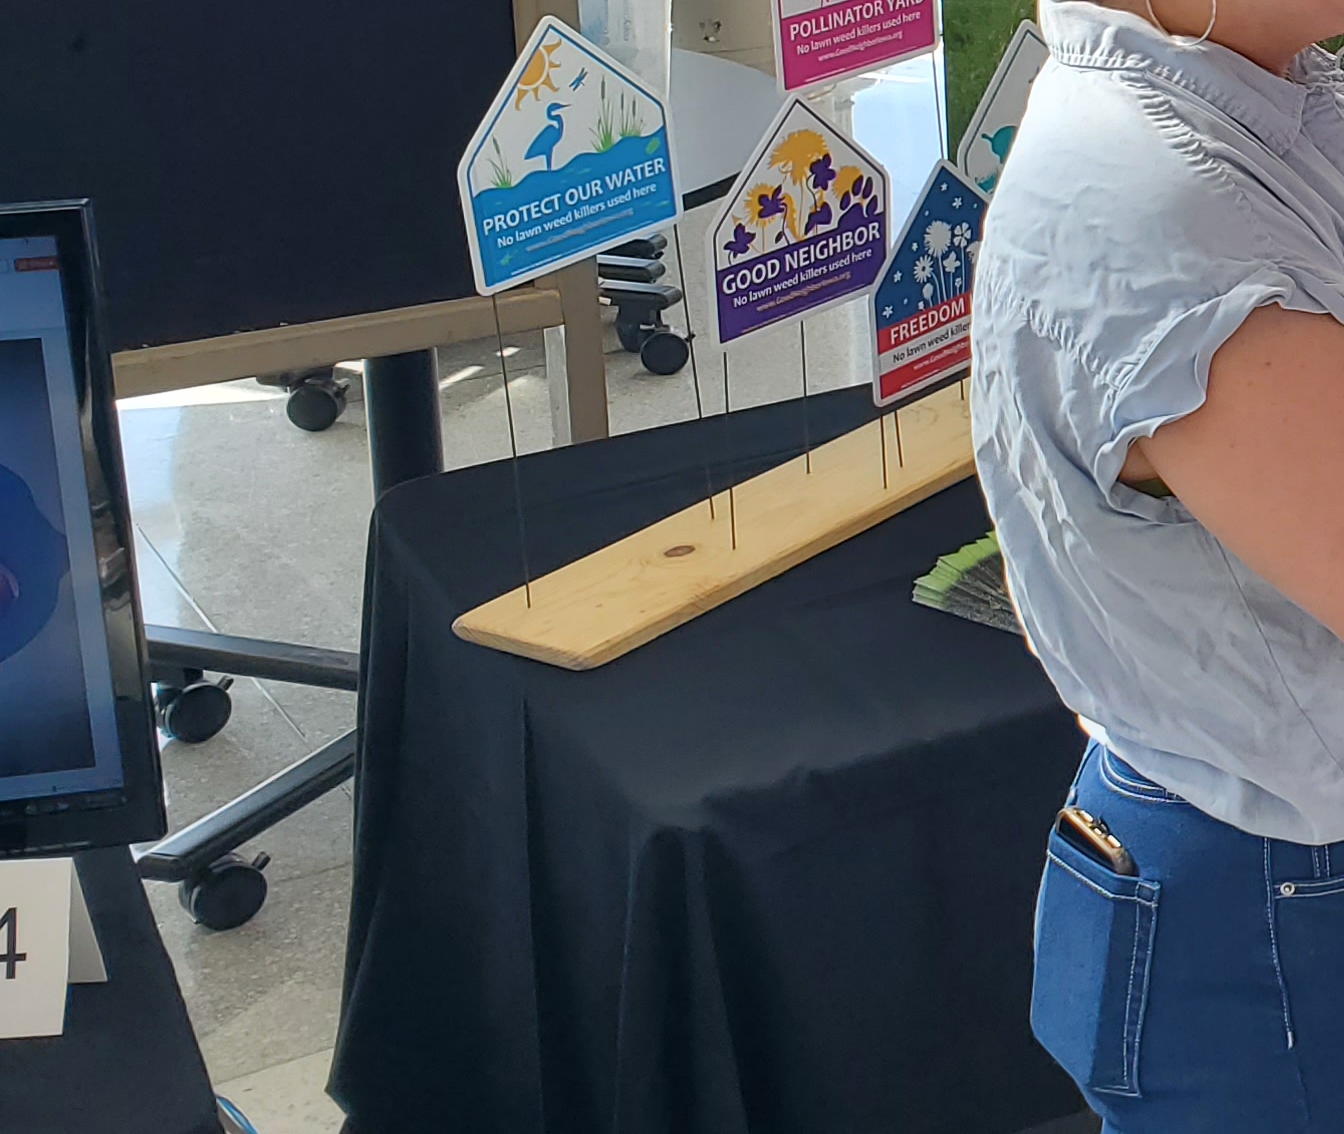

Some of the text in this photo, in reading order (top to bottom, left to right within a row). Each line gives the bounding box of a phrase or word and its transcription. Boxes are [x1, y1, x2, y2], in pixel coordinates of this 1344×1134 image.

[789, 0, 884, 42] POLLINATOR
[796, 10, 921, 56] No lawn weed killers used here
[482, 193, 562, 237] PROTECT
[564, 179, 604, 206] OUR
[604, 157, 667, 192] WATER
[497, 236, 514, 249] No
[515, 224, 542, 242] lawn
[543, 211, 573, 231] weed
[574, 202, 606, 221] killers
[607, 189, 632, 209] used
[632, 183, 657, 199] here
[722, 222, 881, 295] GOOD NEIGHBOR
[733, 248, 873, 308] No lawn weed killers used here
[890, 297, 965, 345] FREEDOM
[893, 352, 904, 364] No
[906, 342, 927, 357] lawn
[927, 330, 950, 348] weed
[950, 321, 970, 337] killer
[0, 907, 27, 980] 4
